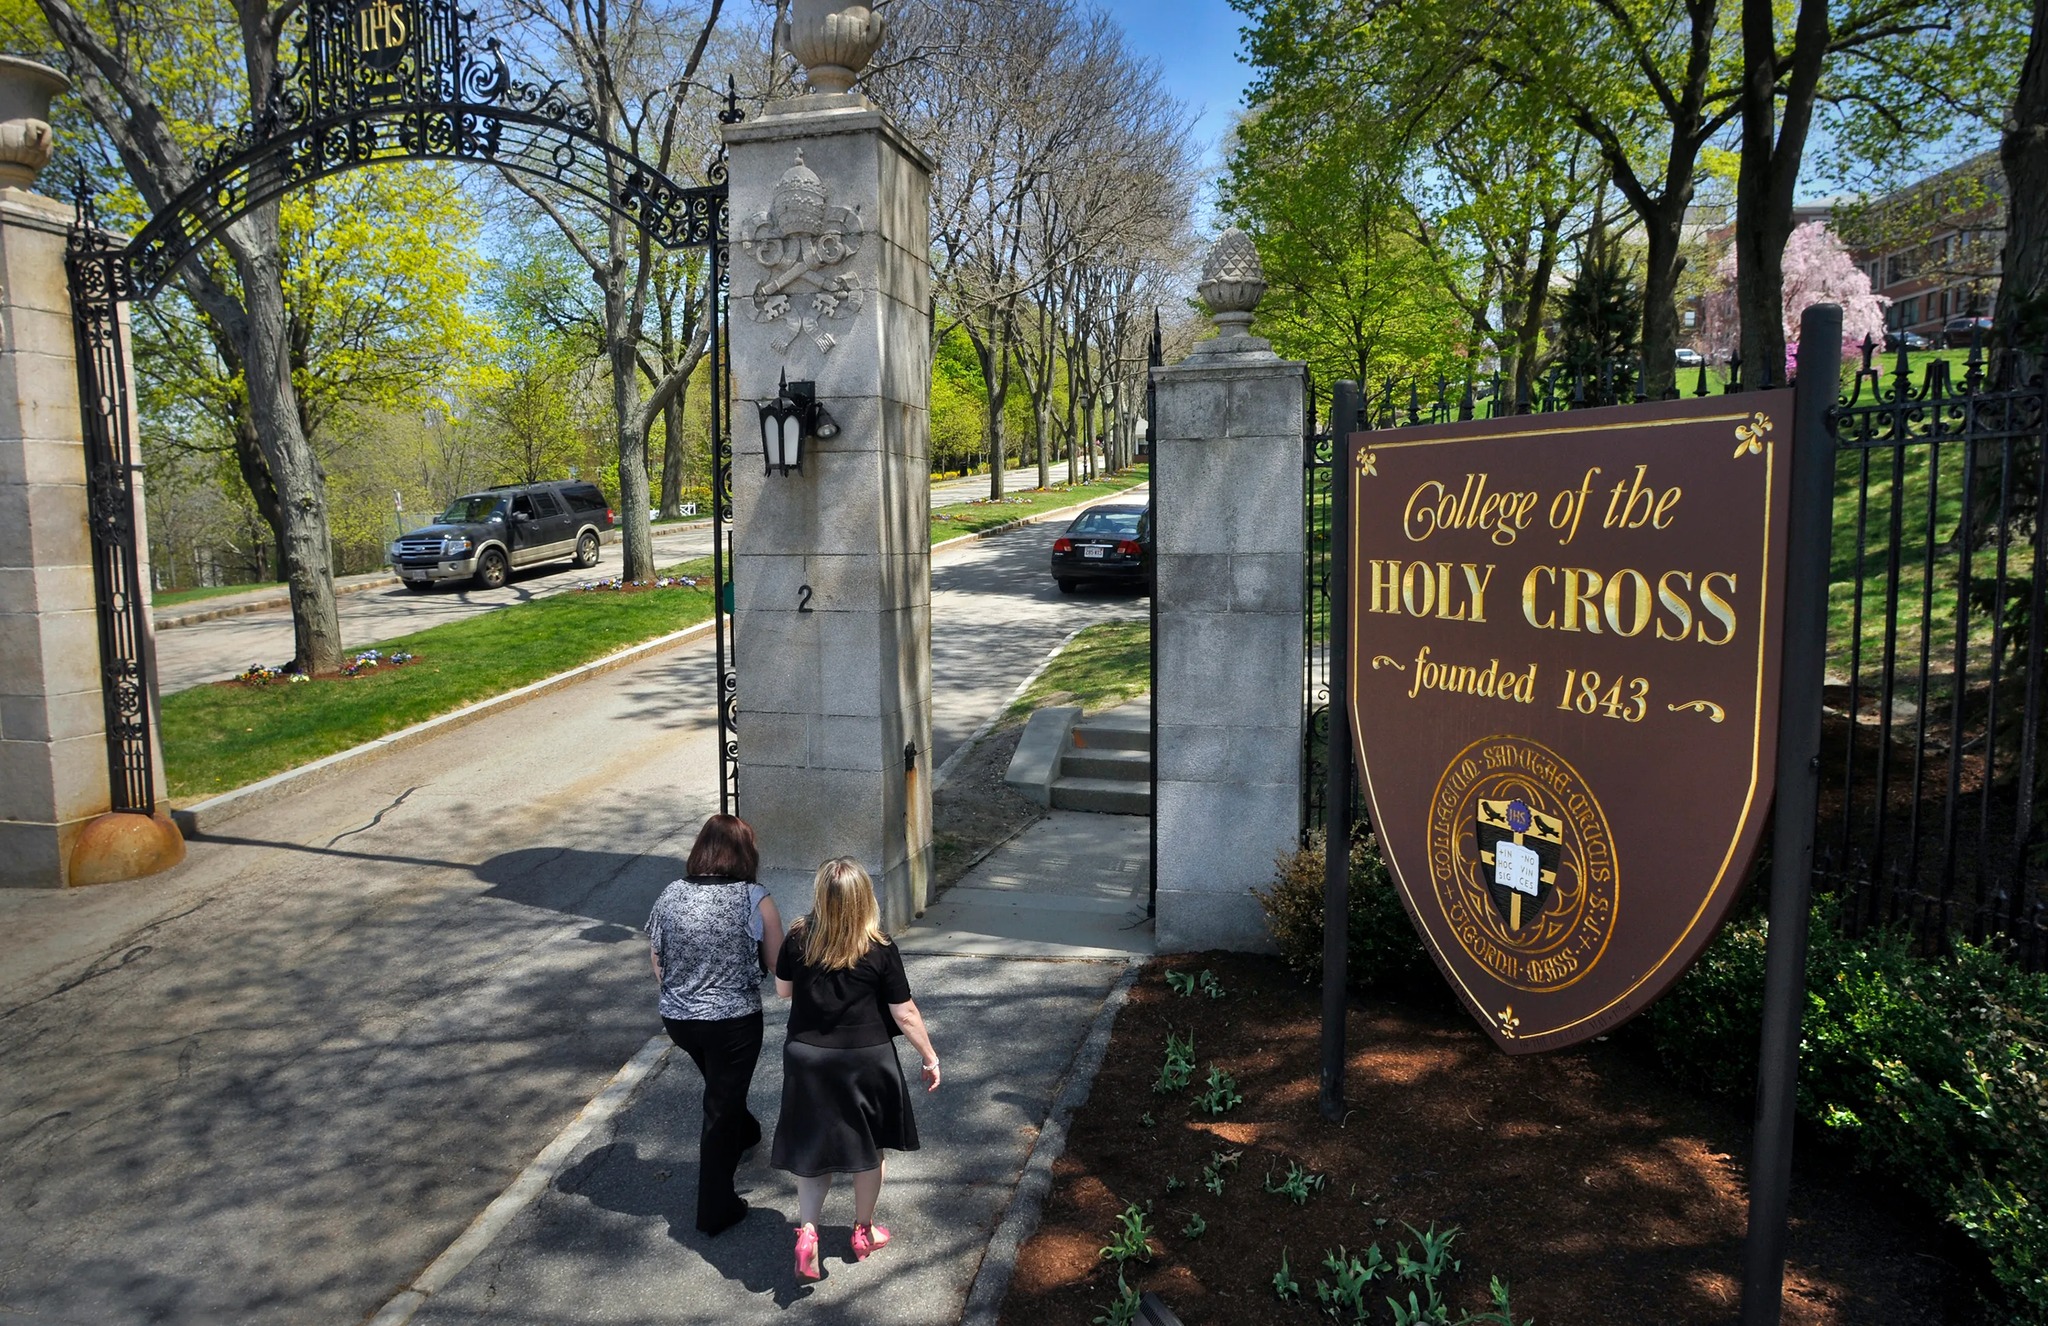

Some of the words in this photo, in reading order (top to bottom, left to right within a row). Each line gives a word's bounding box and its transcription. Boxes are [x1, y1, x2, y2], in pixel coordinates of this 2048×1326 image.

[1403, 473, 1538, 546] College
[1549, 466, 1601, 546] of
[1603, 464, 1682, 530] the
[798, 584, 813, 613] 2
[1368, 559, 1496, 623] HOLY
[1521, 564, 1737, 646] CROSS
[1408, 646, 1538, 704] founded
[1556, 668, 1650, 723] 1843
[1498, 860, 1513, 870] HOC
[1520, 866, 1534, 877] VIN
[1498, 871, 1512, 881] SIG
[1519, 877, 1534, 890] CES
